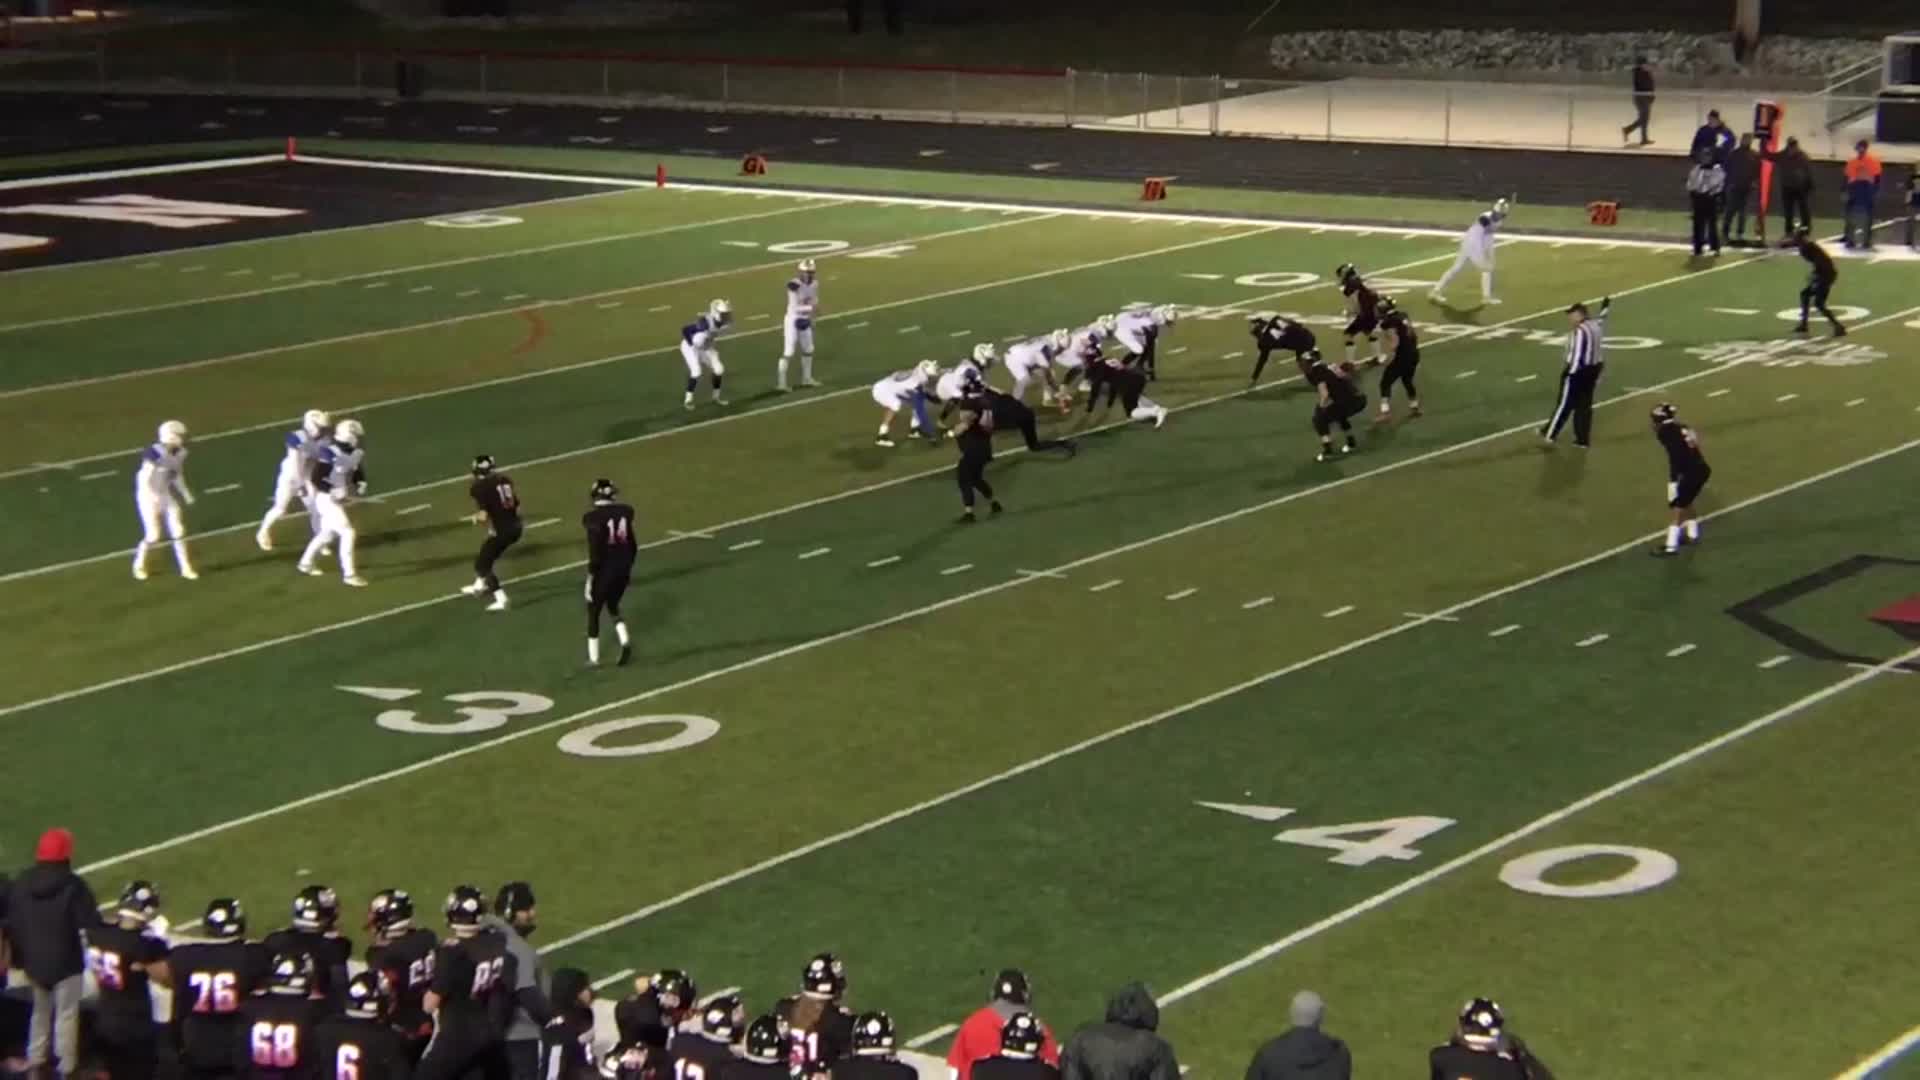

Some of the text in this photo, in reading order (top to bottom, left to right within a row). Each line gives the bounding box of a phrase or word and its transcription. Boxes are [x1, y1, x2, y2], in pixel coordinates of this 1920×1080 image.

[607, 517, 628, 544] 14
[375, 691, 721, 757] 30
[1272, 815, 1679, 898] 40
[188, 971, 240, 1013] 76
[251, 1020, 298, 1068] 68
[336, 1043, 361, 1080] 6
